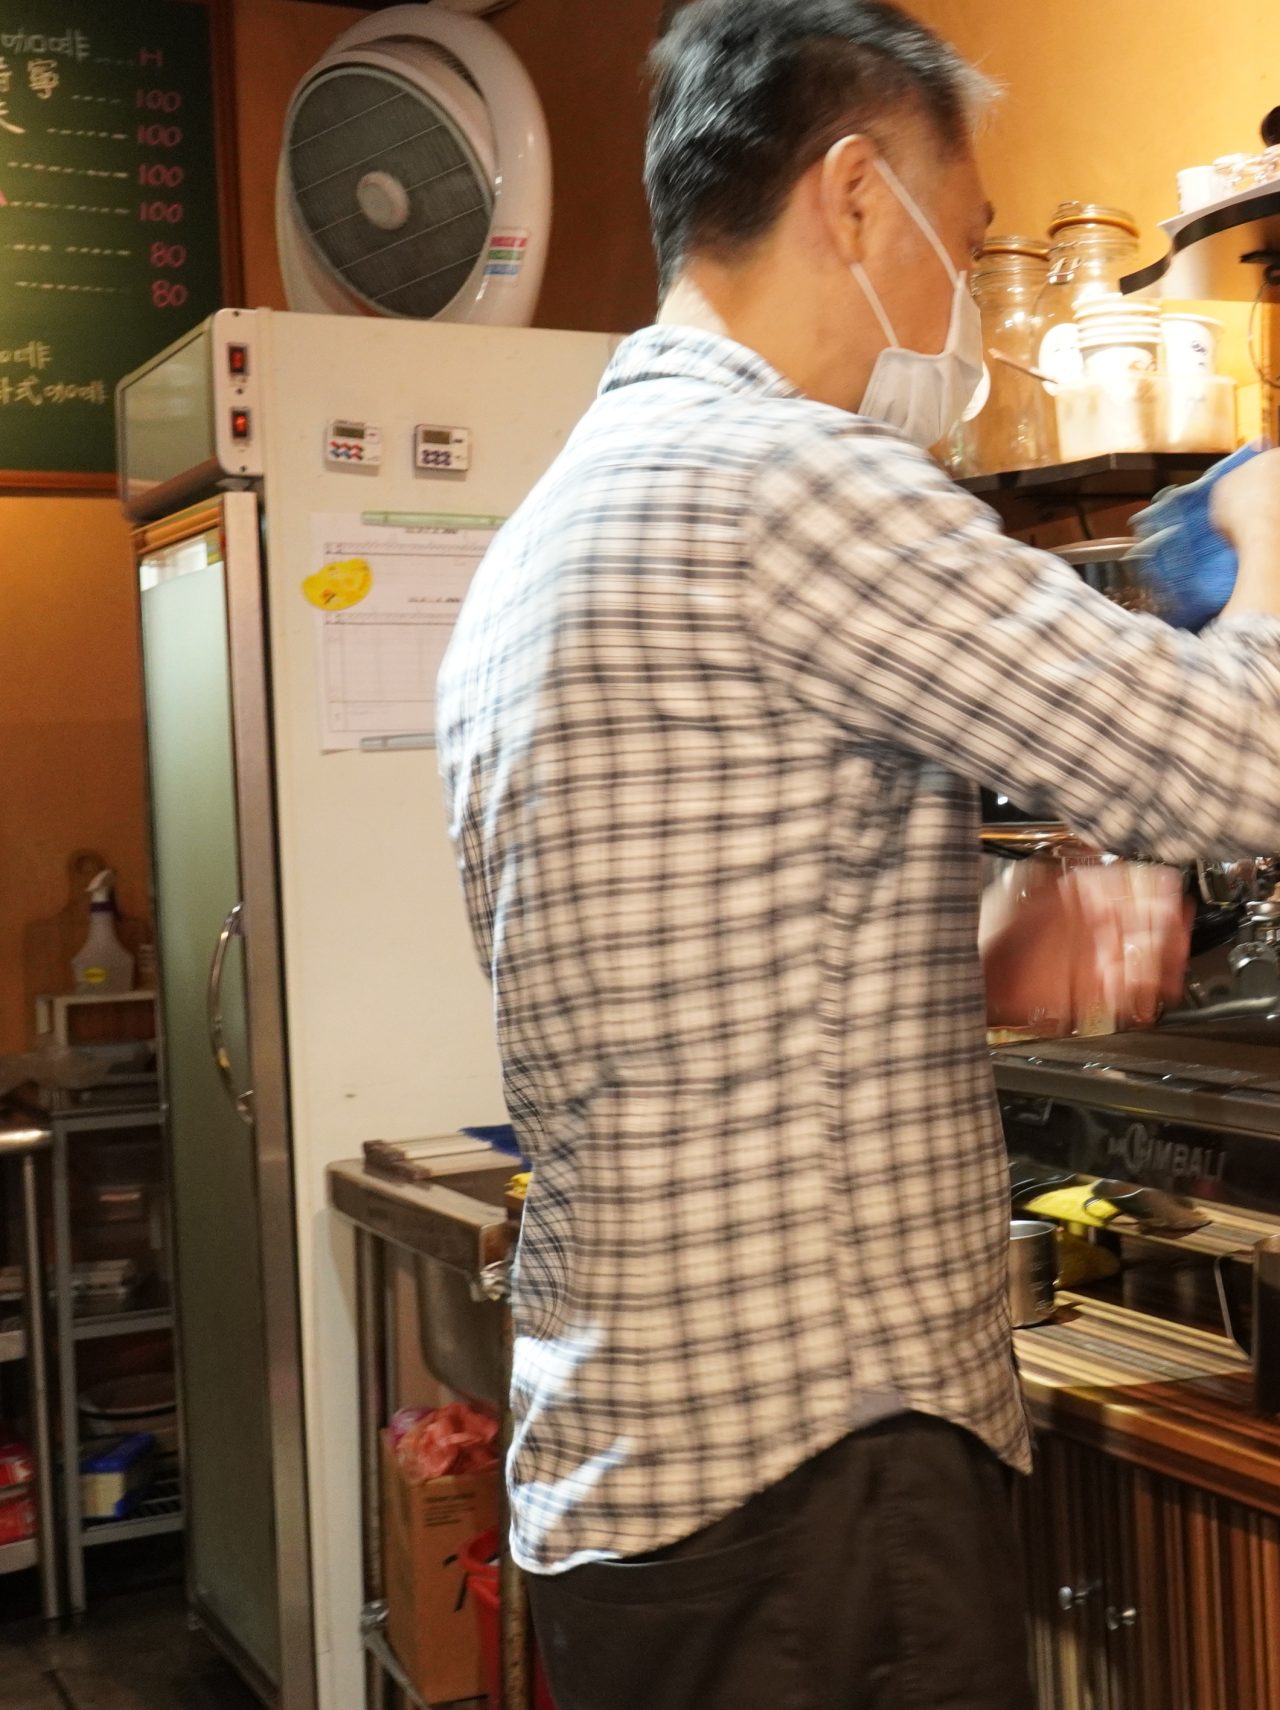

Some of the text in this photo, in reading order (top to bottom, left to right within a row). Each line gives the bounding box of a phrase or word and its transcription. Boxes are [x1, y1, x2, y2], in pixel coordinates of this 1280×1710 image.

[135, 89, 183, 113] 100
[137, 123, 184, 147] 100
[138, 164, 185, 188] 100
[138, 201, 185, 224] 100
[149, 241, 188, 268] 80
[151, 279, 189, 308] 80
